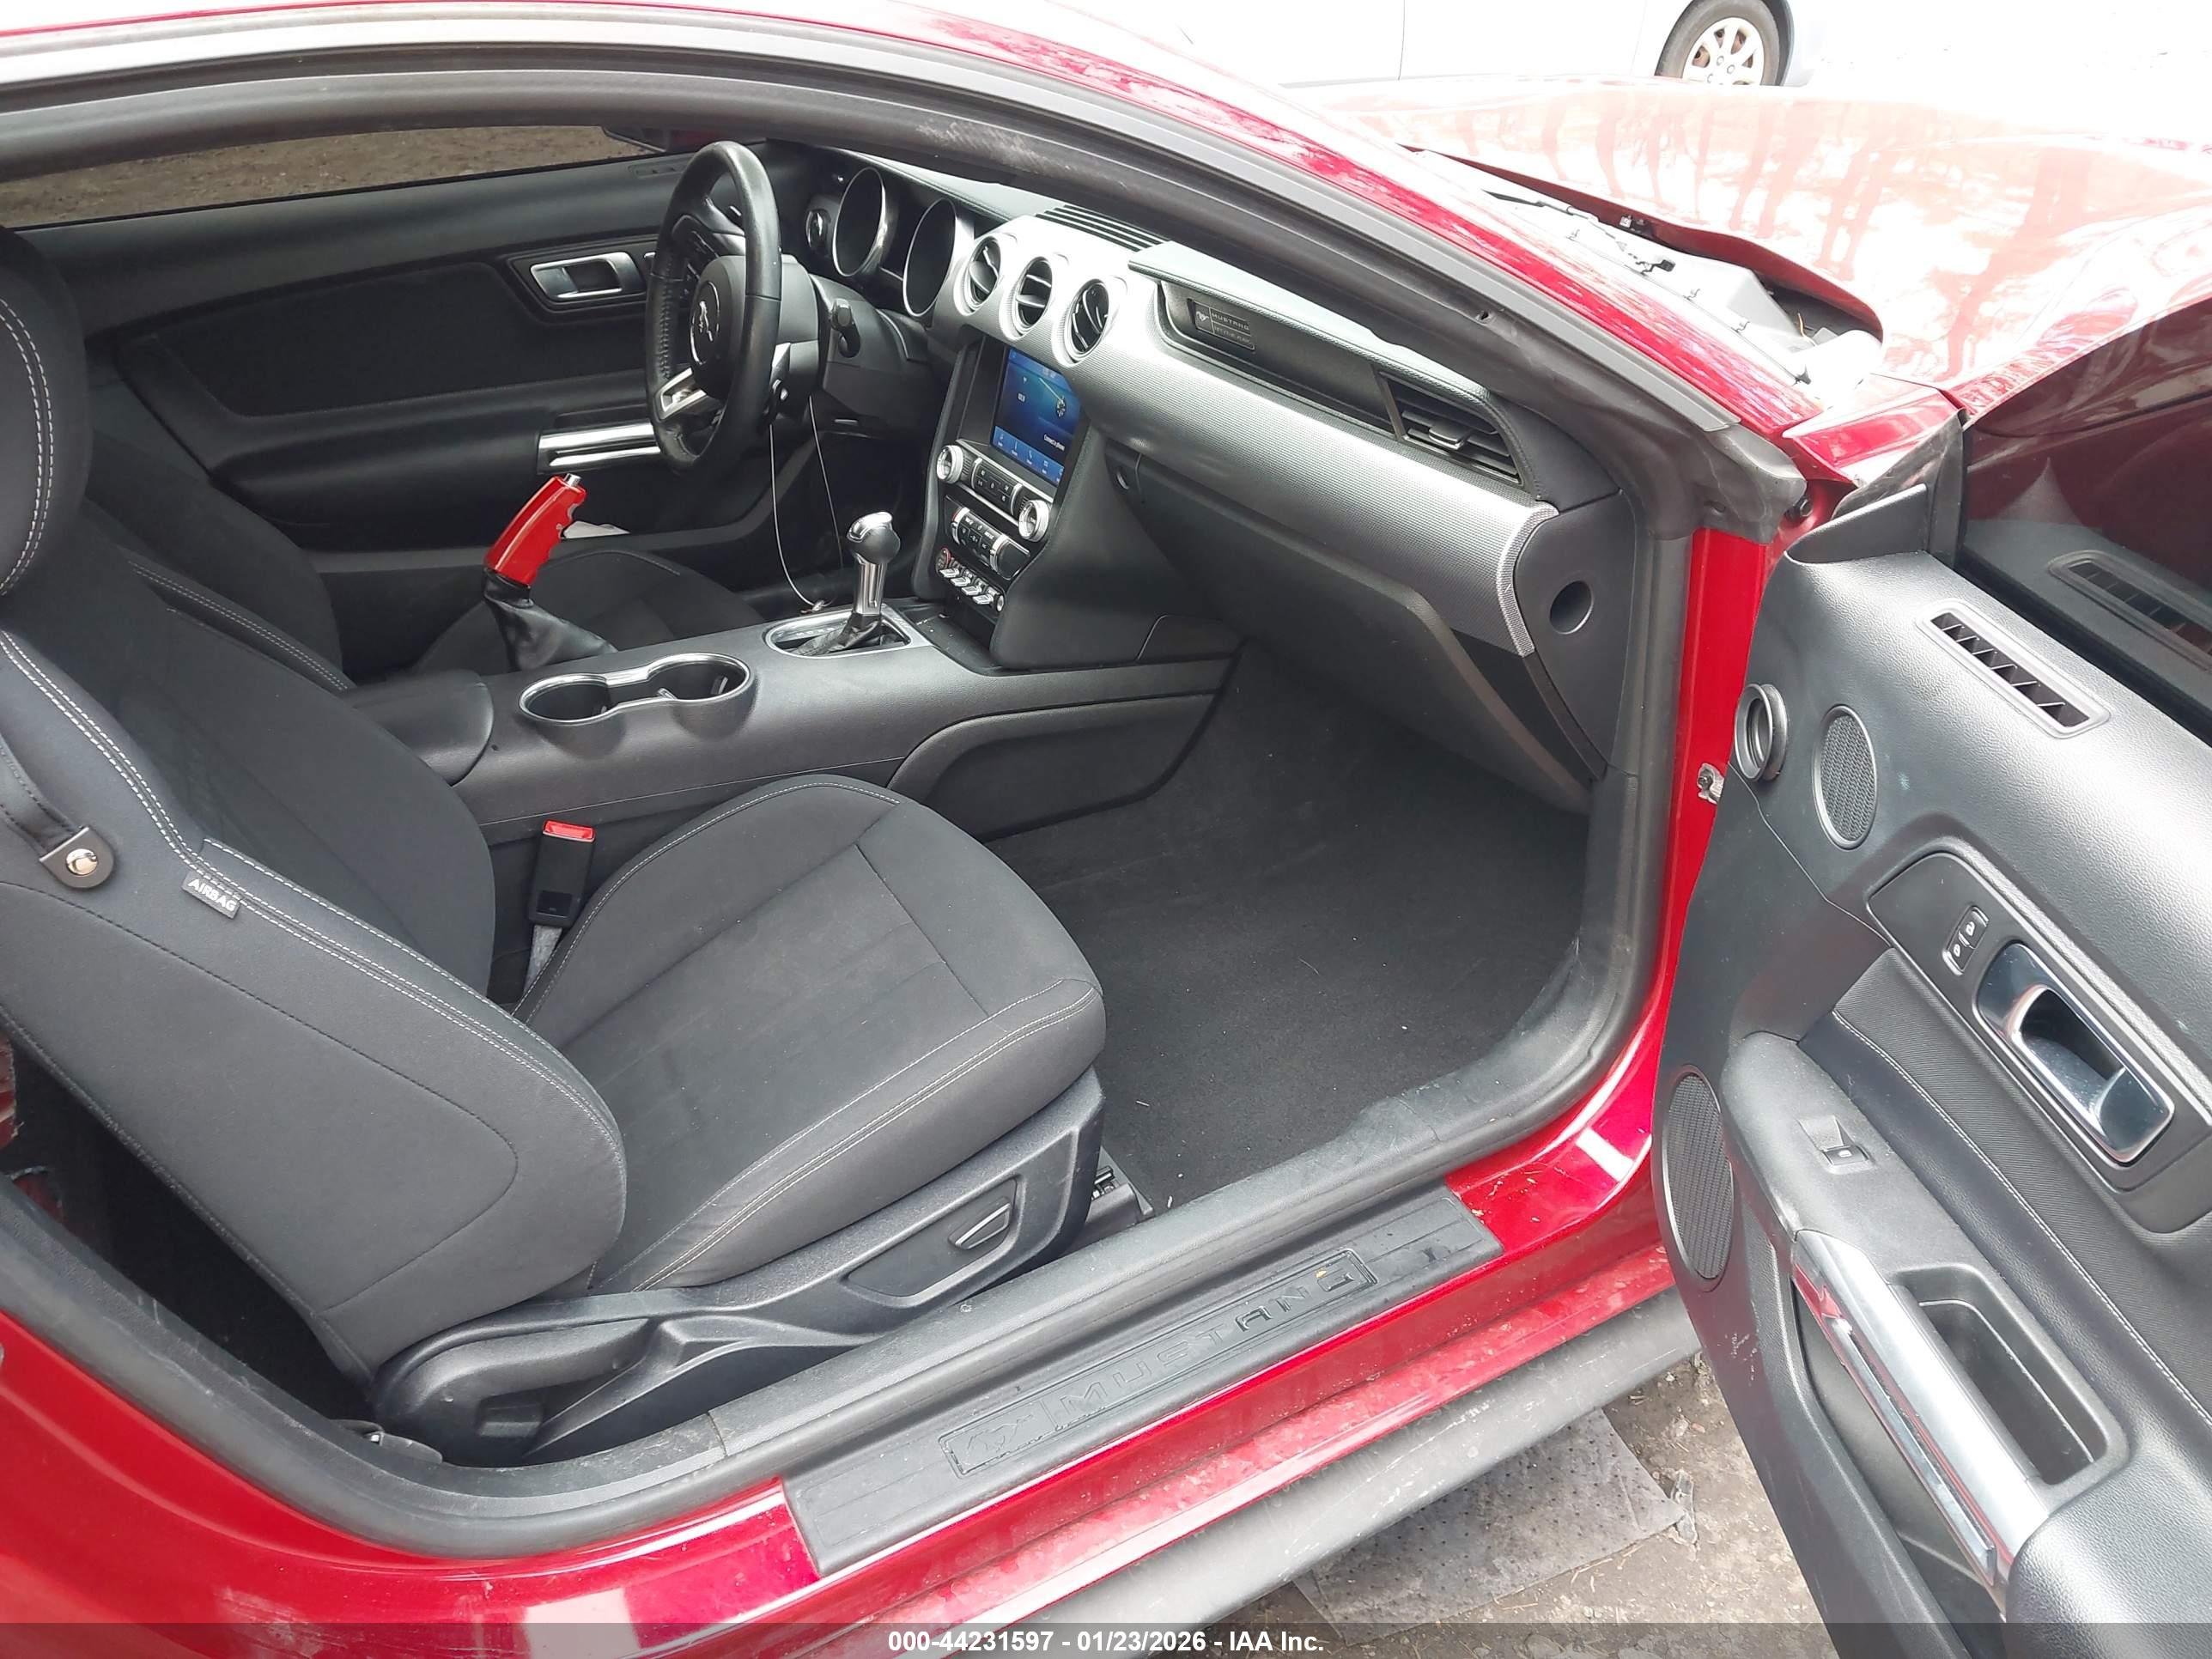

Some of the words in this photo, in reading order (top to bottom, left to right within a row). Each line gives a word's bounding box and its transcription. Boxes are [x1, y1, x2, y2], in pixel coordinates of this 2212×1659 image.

[1212, 313, 1249, 331] MUSTANG
[187, 878, 237, 912] AIRBAG
[1059, 1263, 1356, 1416] MUSTANG
